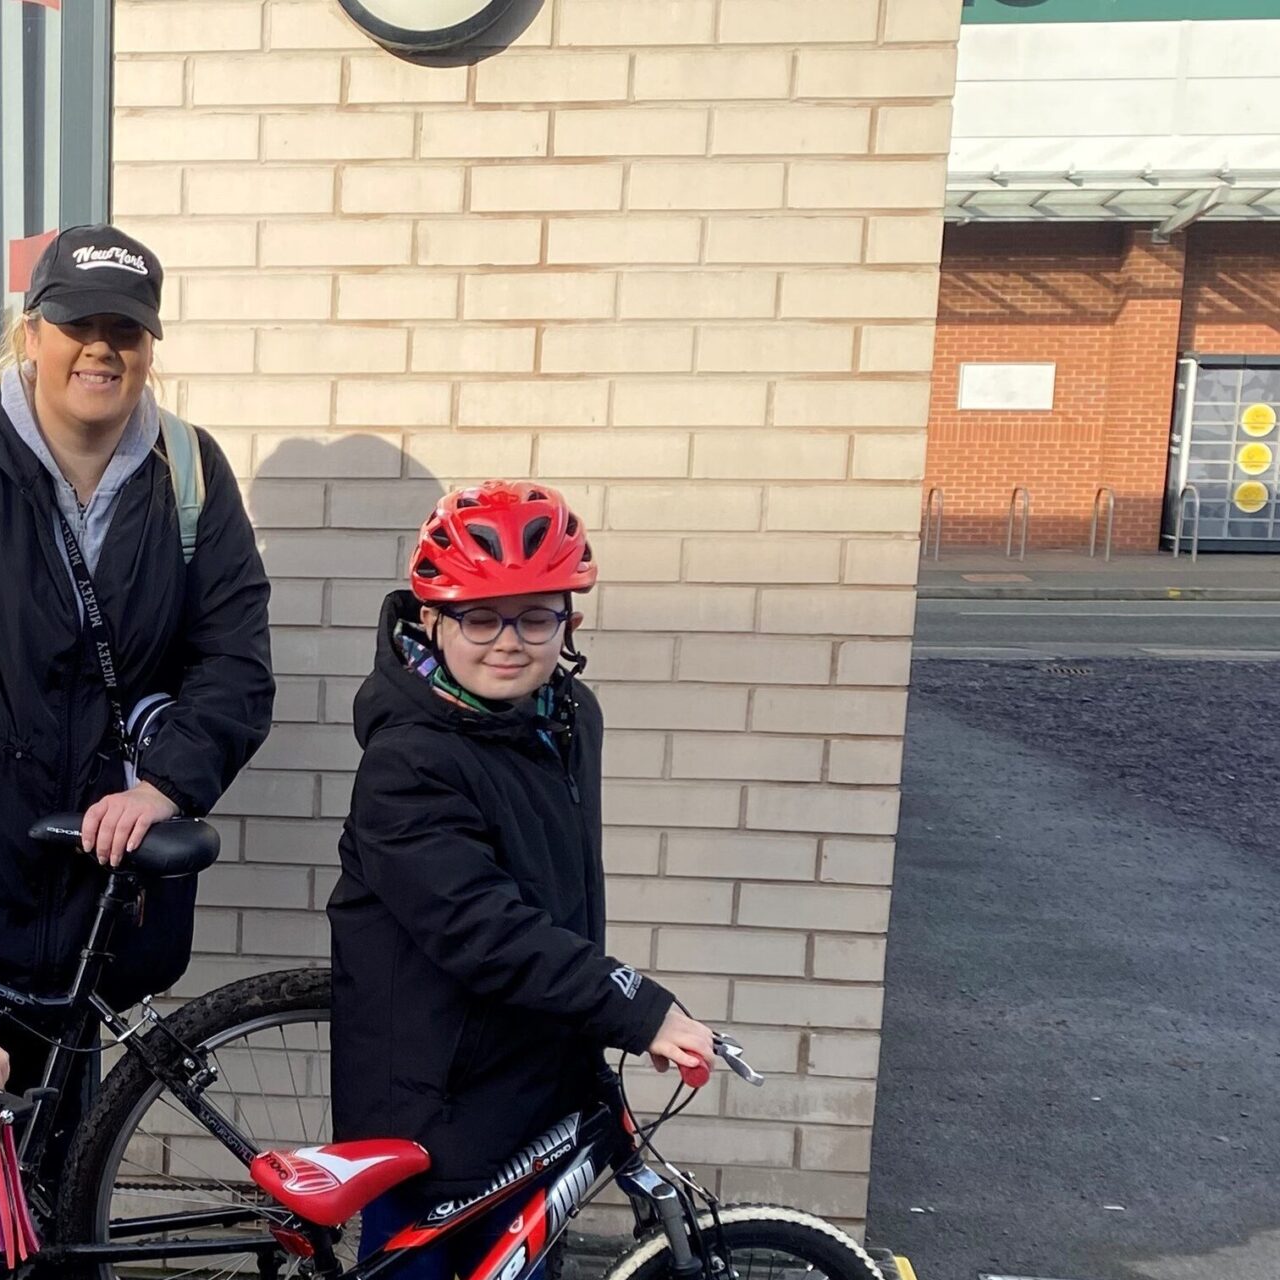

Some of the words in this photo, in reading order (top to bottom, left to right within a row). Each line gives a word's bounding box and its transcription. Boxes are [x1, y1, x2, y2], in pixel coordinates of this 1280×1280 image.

[78, 580, 103, 628] MICKEY
[97, 641, 117, 688] MICKEY
[46, 826, 82, 836] apoll
